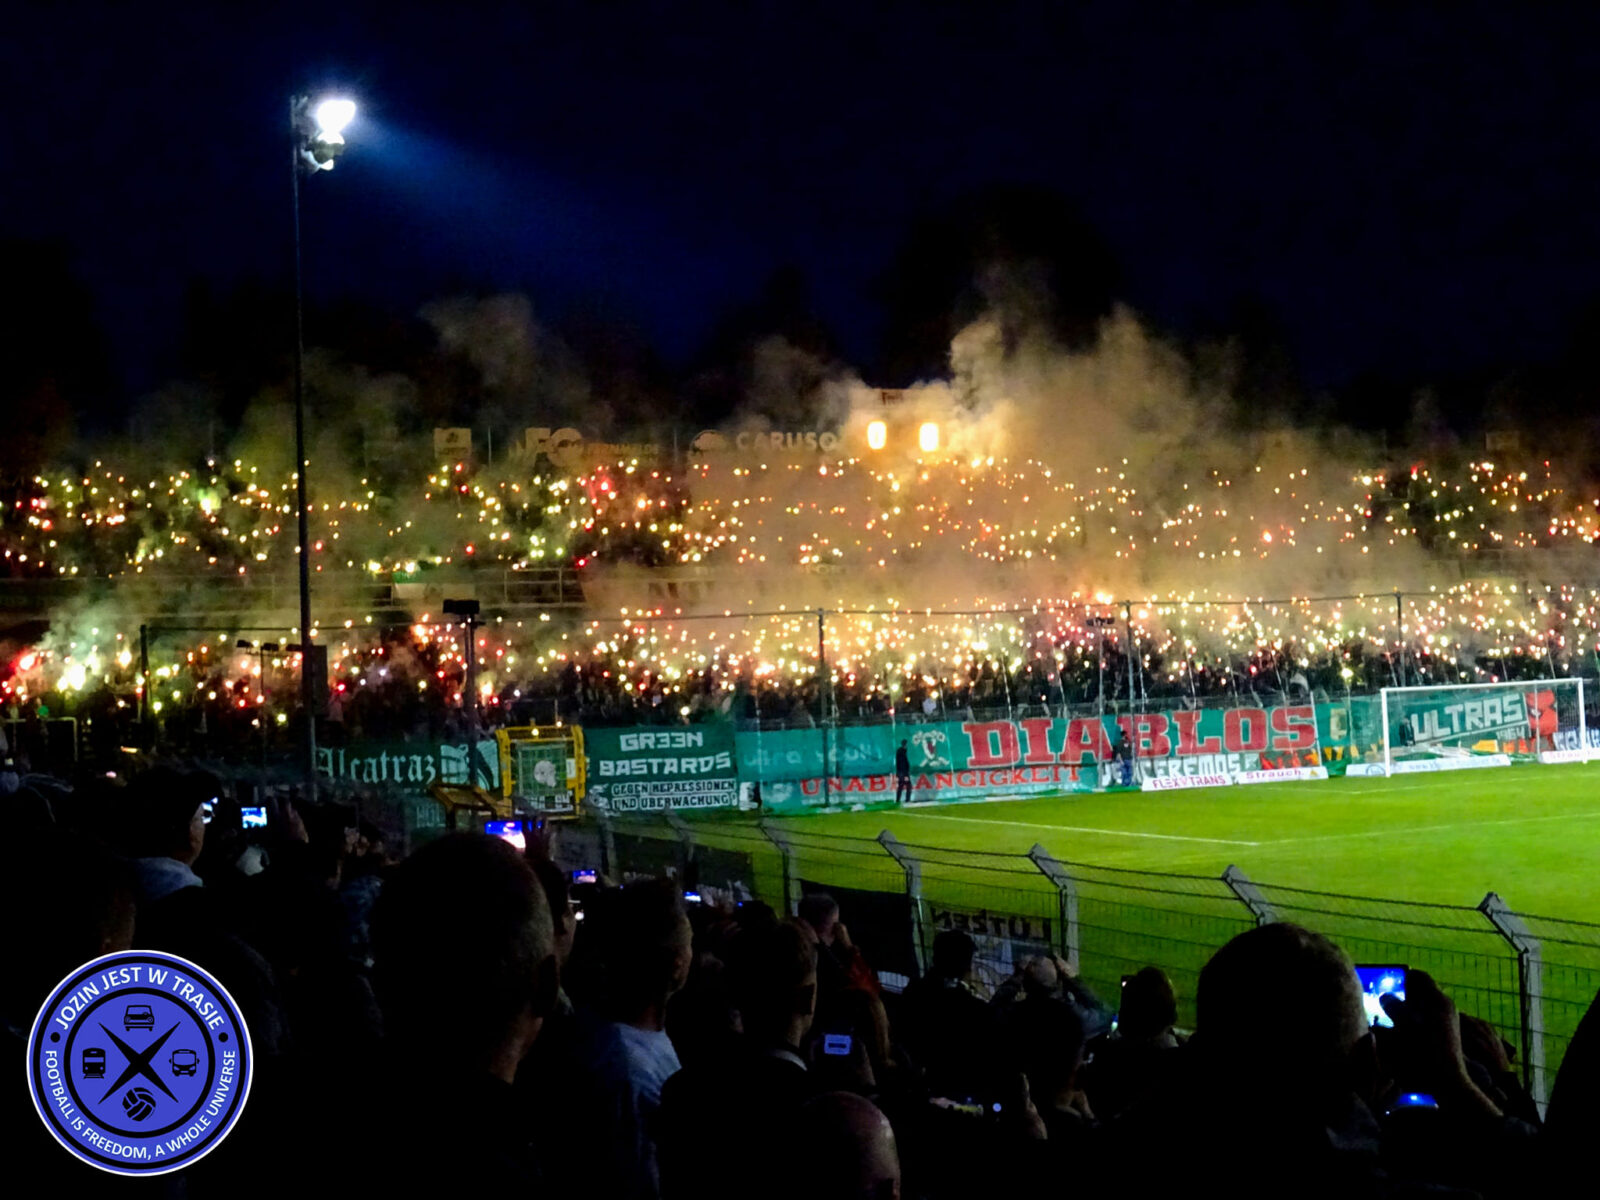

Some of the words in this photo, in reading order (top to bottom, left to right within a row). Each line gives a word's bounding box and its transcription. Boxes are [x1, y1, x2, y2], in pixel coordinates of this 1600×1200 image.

[735, 431, 838, 451] CARUSO
[1411, 693, 1524, 742] ULTRAS
[962, 706, 1318, 768] DIABLOS
[315, 747, 437, 785] Alcatraz
[598, 752, 732, 777] BASTARDS
[612, 783, 649, 796] GEGEN
[651, 780, 736, 794] REPRESSIONEN
[613, 797, 638, 810] UND
